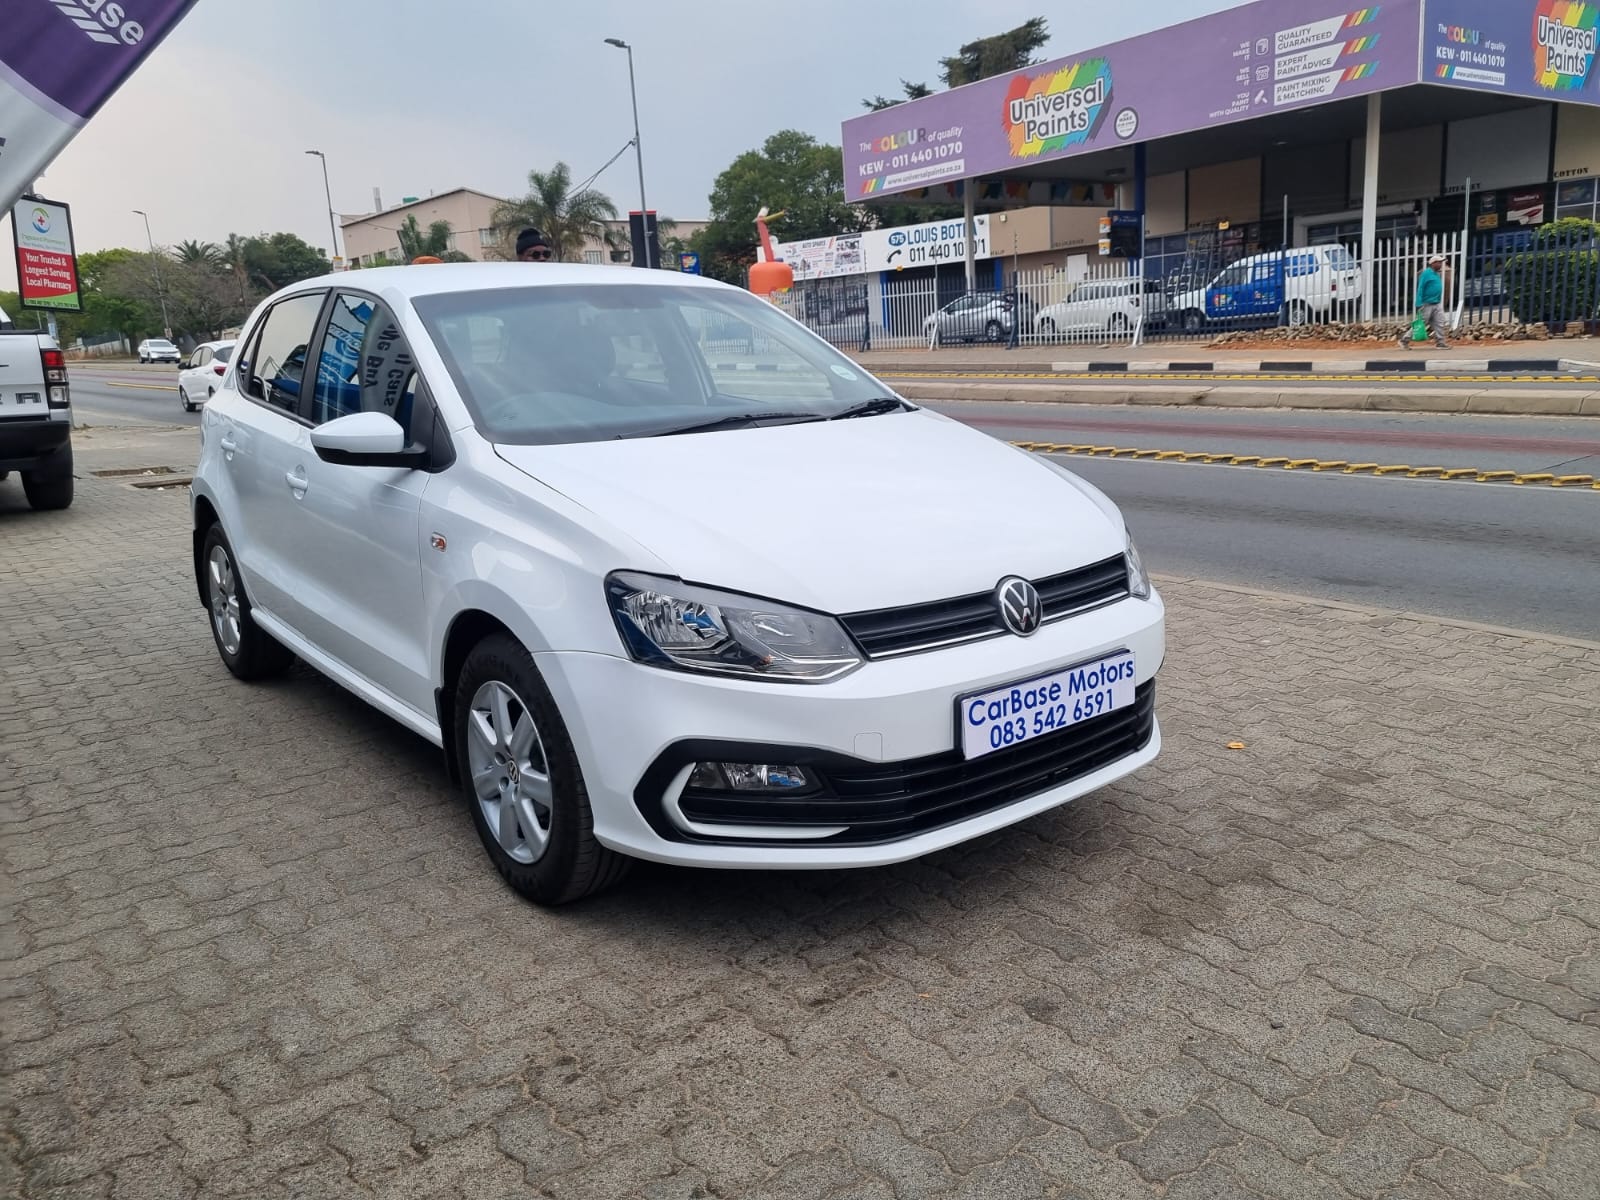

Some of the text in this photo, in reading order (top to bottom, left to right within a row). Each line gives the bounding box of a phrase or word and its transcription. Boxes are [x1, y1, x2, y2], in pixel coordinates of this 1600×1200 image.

[1277, 27, 1311, 42] QUALITY
[1438, 23, 1447, 34] The
[1538, 16, 1596, 52] Universal
[1277, 31, 1332, 50] GUARANTEED
[1277, 54, 1308, 68] EXPERT
[1436, 45, 1455, 60] KEW
[1460, 49, 1472, 63] 011
[1472, 52, 1487, 65] 440
[1488, 54, 1505, 68] 1070
[1547, 46, 1585, 75] Paints
[1277, 57, 1331, 75] PAINT ADVICE
[1277, 76, 1330, 93] PAINT MIXING
[1283, 85, 1325, 99] MATCHING
[1010, 78, 1103, 122] Universal
[1224, 104, 1249, 115] QUALITY
[1026, 109, 1088, 141] Paints
[859, 126, 963, 153] The COLOUR of quality
[859, 160, 884, 176] KEW
[892, 154, 908, 168] 011
[911, 148, 932, 163] 440
[934, 141, 963, 158] 1070
[1554, 167, 1589, 178] COTTON
[907, 227, 937, 245] LOUIS
[25, 252, 67, 266] Your Trusted &
[909, 246, 926, 262] 011
[929, 244, 950, 260] 440
[25, 264, 70, 280] Longest Serving
[26, 277, 71, 291] Local Pharmacy
[968, 660, 1134, 726] CarBase Motors
[990, 688, 1113, 748] 083 542 6591
